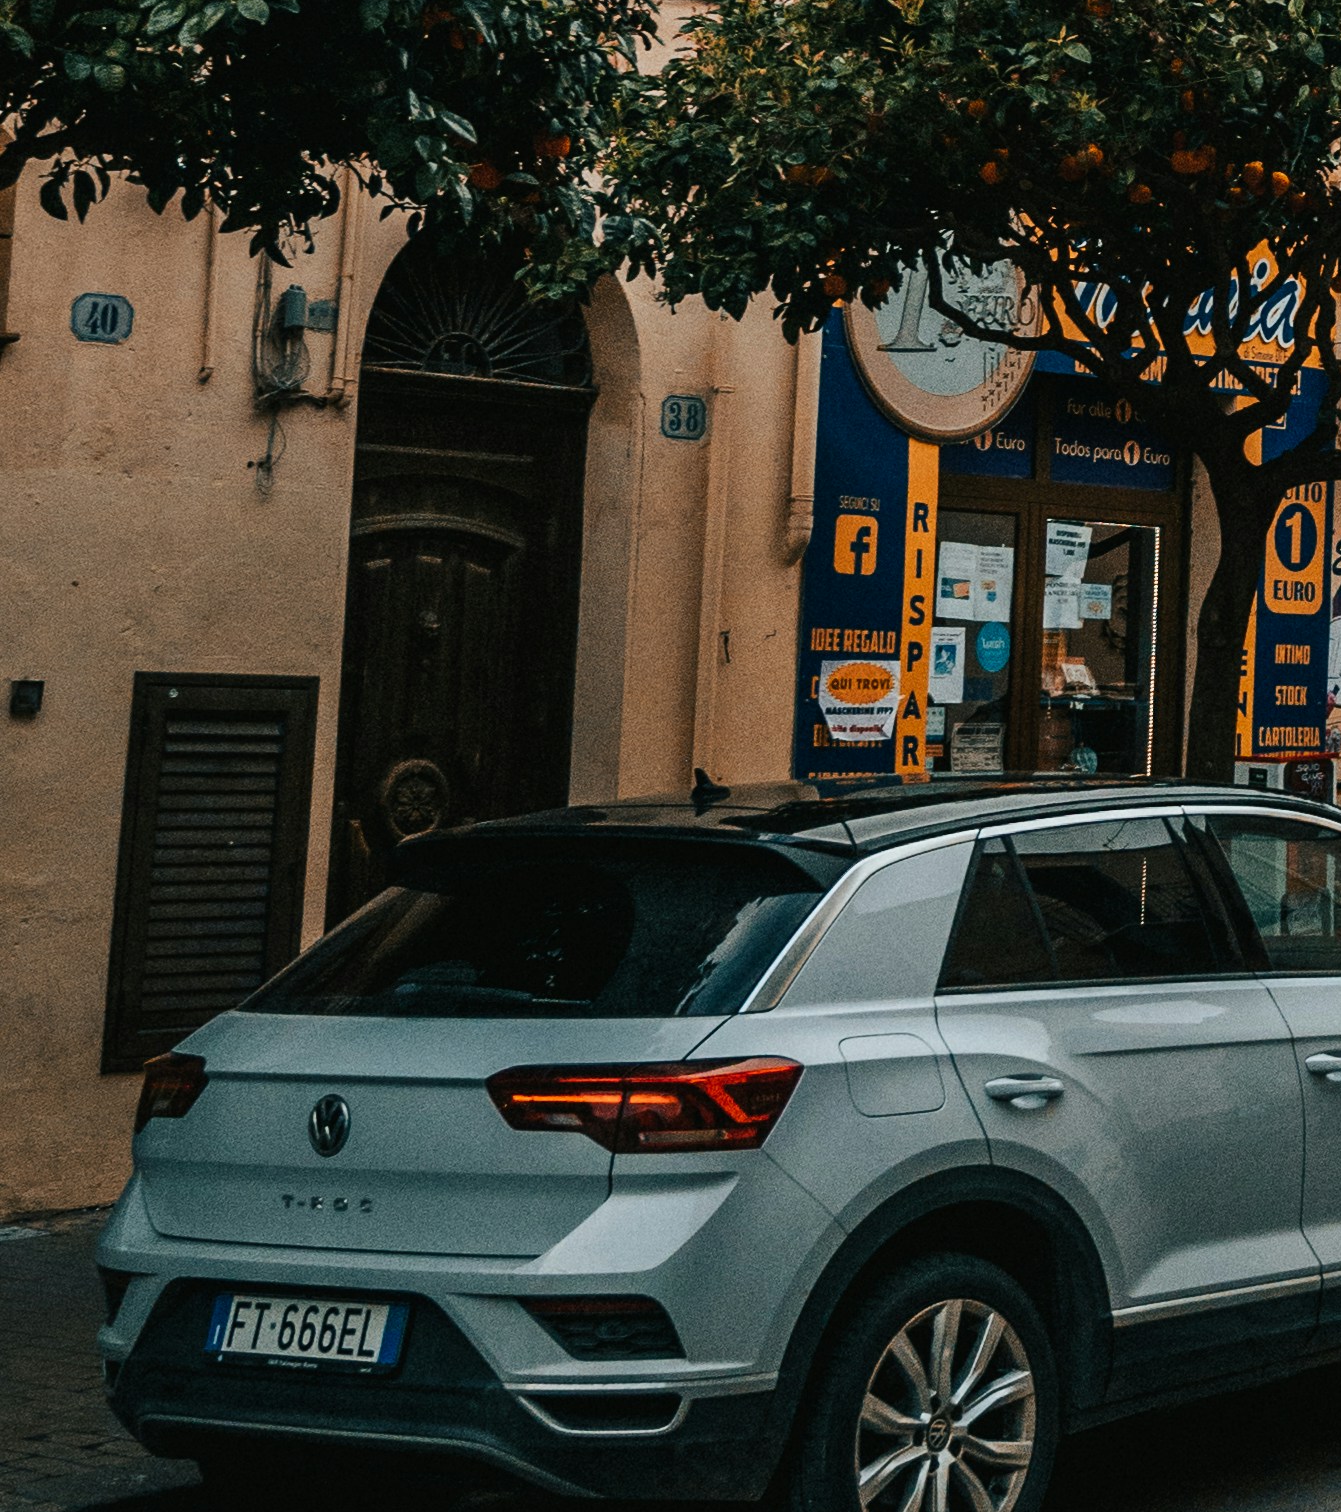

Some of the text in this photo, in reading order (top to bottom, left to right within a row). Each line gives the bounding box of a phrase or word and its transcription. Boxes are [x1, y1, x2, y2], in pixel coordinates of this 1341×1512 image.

[82, 301, 119, 335] 40
[669, 401, 698, 432] 38
[996, 432, 1026, 451] Euro
[1054, 437, 1091, 458] Todos
[1093, 446, 1122, 463] para
[1143, 447, 1171, 465] Euro
[838, 495, 869, 510] SEGUICI
[1285, 511, 1303, 564] 1
[1272, 579, 1316, 603] EURO
[811, 627, 896, 654] IDEE REGALO
[1275, 644, 1311, 665] INTIMO
[830, 678, 852, 690] QUI
[856, 678, 891, 690] TROVI
[1275, 684, 1307, 706] STOCK
[1259, 726, 1321, 747] CARTOLERIA
[226, 1300, 272, 1350] FT
[277, 1303, 375, 1359] 666EL
